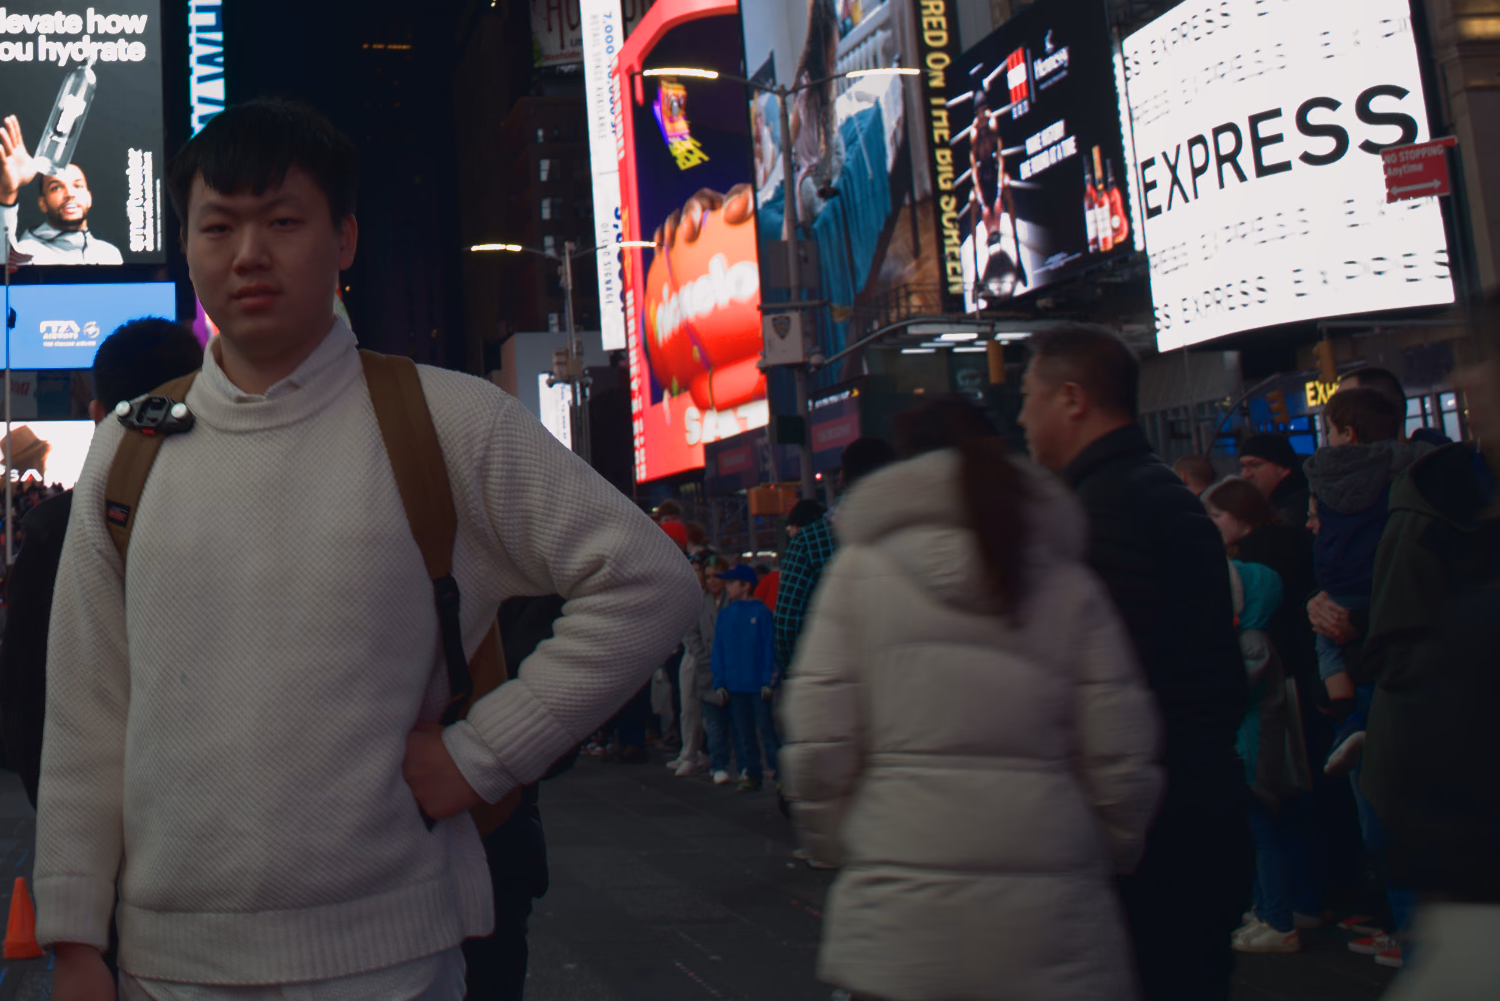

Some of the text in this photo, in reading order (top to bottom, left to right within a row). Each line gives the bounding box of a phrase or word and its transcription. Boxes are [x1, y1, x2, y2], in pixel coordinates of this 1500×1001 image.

[85, 7, 149, 35] how
[37, 34, 147, 67] hydrate
[925, 56, 953, 89] ON
[1139, 84, 1419, 221] EXPRESS
[1384, 144, 1444, 165] NO STOPPING
[1386, 162, 1424, 177] Anytime
